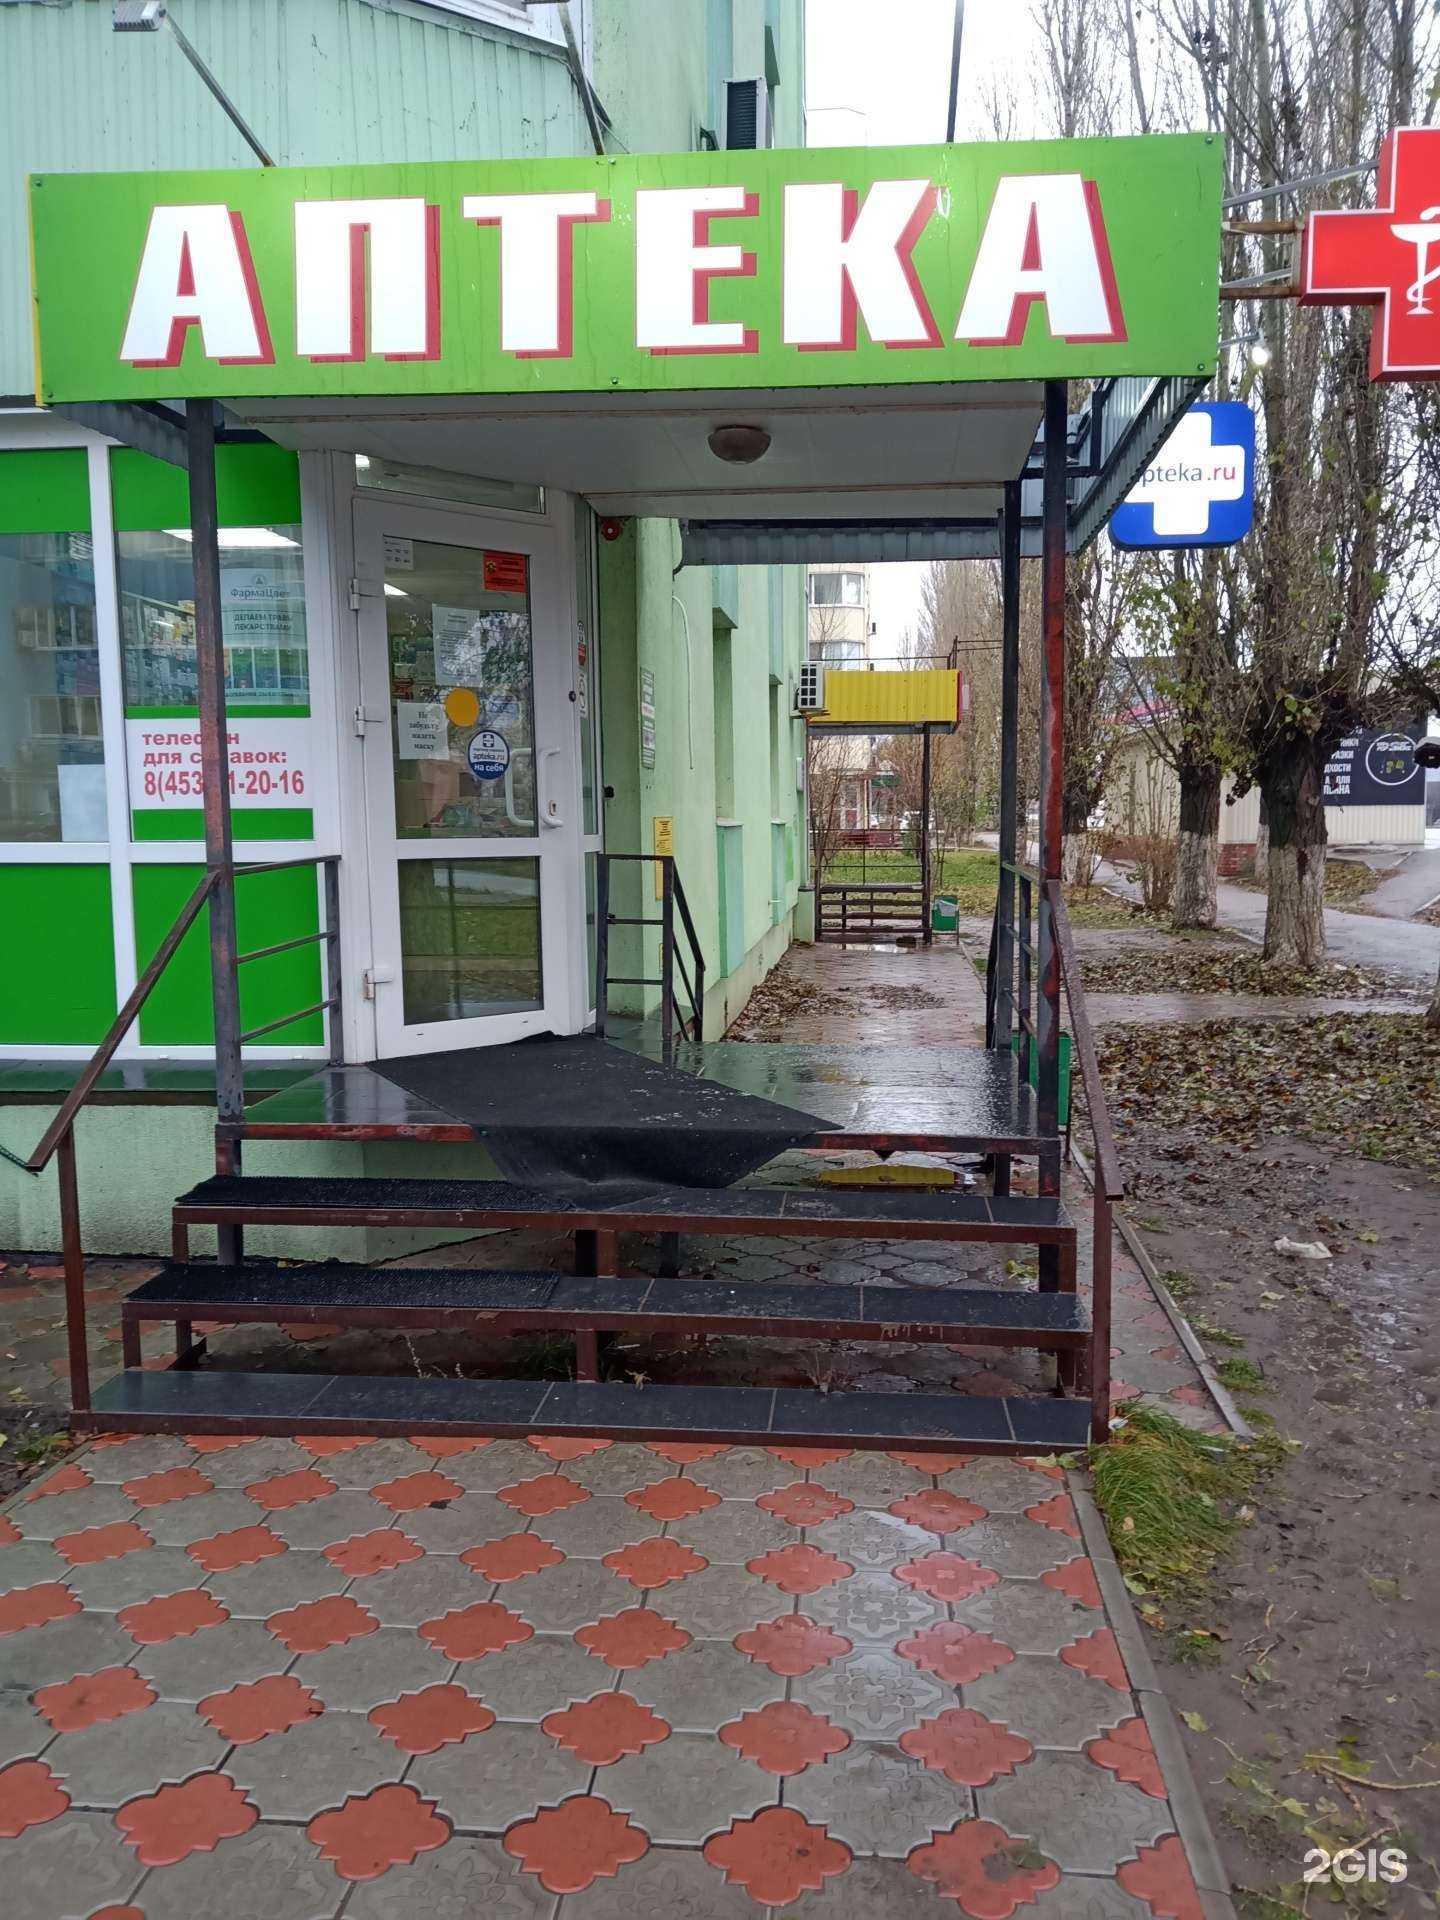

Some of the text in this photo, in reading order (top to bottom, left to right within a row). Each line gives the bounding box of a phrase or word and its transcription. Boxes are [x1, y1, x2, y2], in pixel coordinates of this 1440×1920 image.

[119, 171, 1128, 368] АПТЕКА
[1139, 463, 1237, 488] pteka.ru
[143, 751, 288, 768] для савок:
